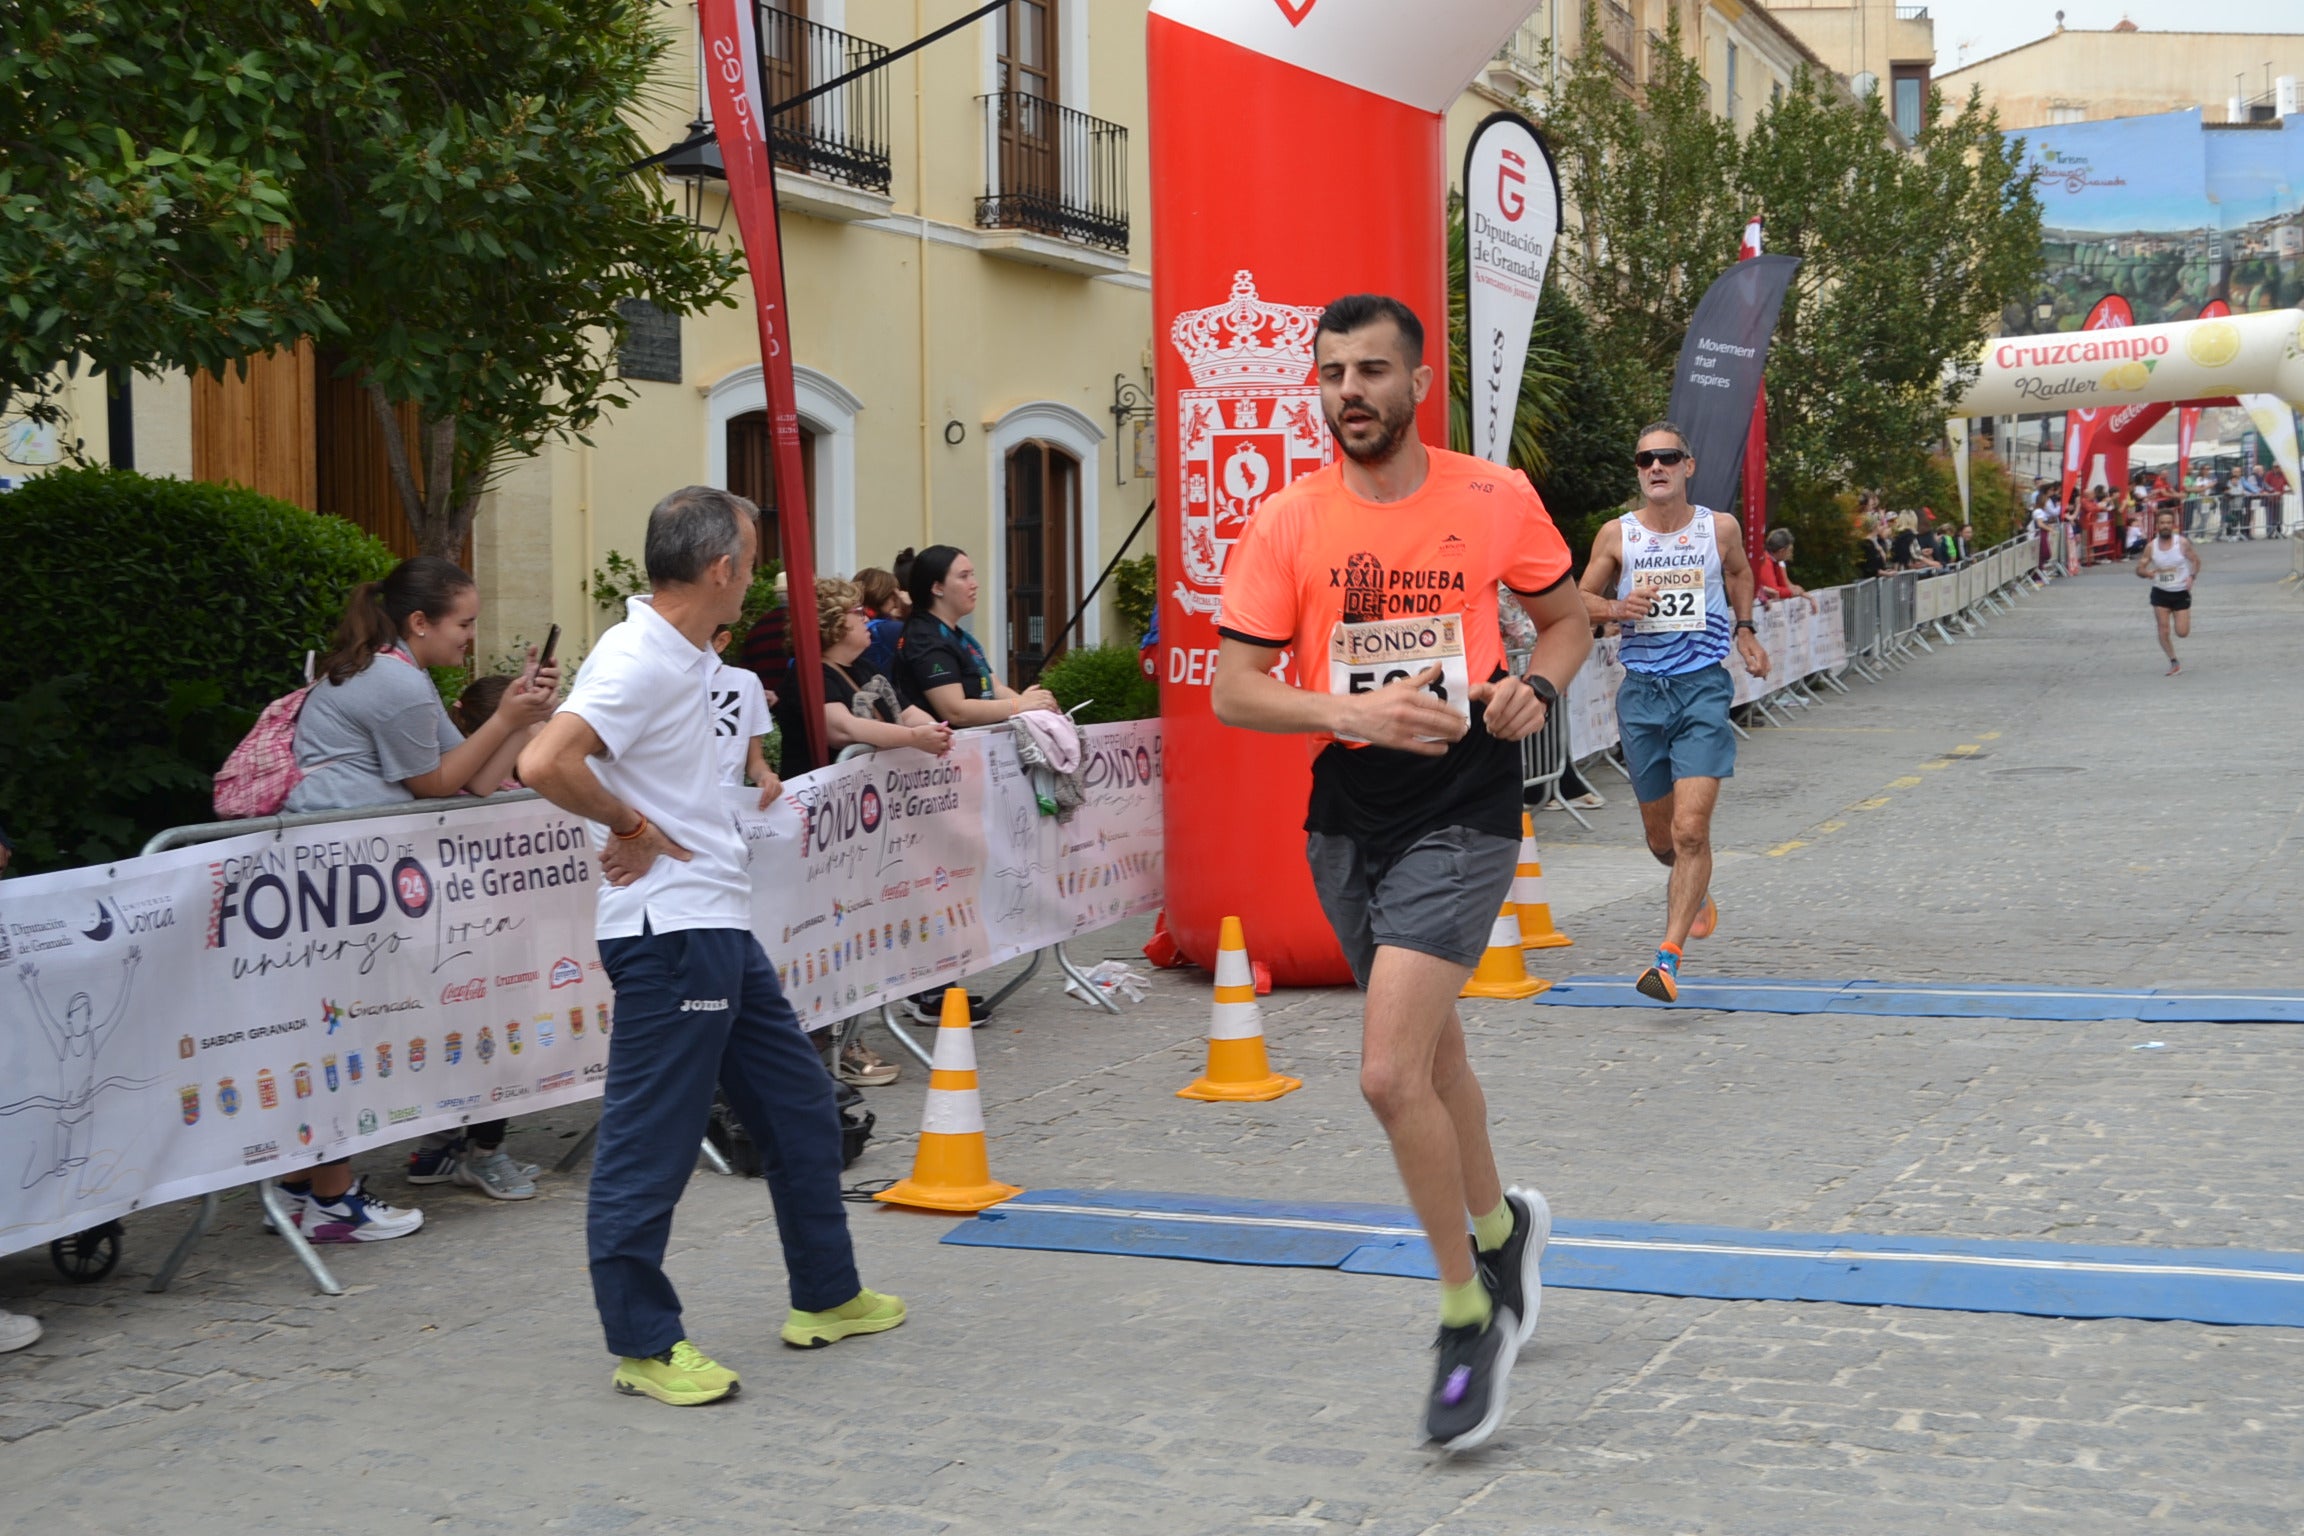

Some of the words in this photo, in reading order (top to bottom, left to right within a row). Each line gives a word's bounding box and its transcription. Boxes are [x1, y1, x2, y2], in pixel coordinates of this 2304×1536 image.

[1474, 212, 1543, 257] Diputación
[1474, 240, 1490, 262] de
[1492, 246, 1541, 282] Granada
[1697, 337, 1756, 359] Movement
[1996, 335, 2170, 370] Cruzcampo
[1694, 355, 1717, 368] that
[1689, 370, 1731, 388] inspires
[2014, 375, 2099, 401] Radler
[1634, 554, 1705, 570] MARACENA
[1329, 568, 1384, 589] XXXII
[1388, 570, 1465, 592] PRUEBA
[1647, 573, 1692, 586] FONDO
[1348, 592, 1375, 613] DE
[1379, 593, 1442, 614] FONDO
[1353, 629, 1437, 653] FONDO
[886, 760, 962, 798] Diputación
[1083, 745, 1151, 789] ONDO
[796, 782, 836, 808] GRAN
[906, 791, 959, 817] Granada
[806, 784, 881, 857] FONDO
[438, 820, 586, 869] Diputación
[223, 842, 287, 885] GRAN
[296, 836, 390, 870] PREMIO
[400, 875, 426, 900] 24
[446, 873, 474, 903] de
[482, 854, 590, 898] Granada
[218, 857, 434, 948] FONDO
[200, 1032, 246, 1050] SABOR
[249, 1018, 309, 1040] GRANADA
